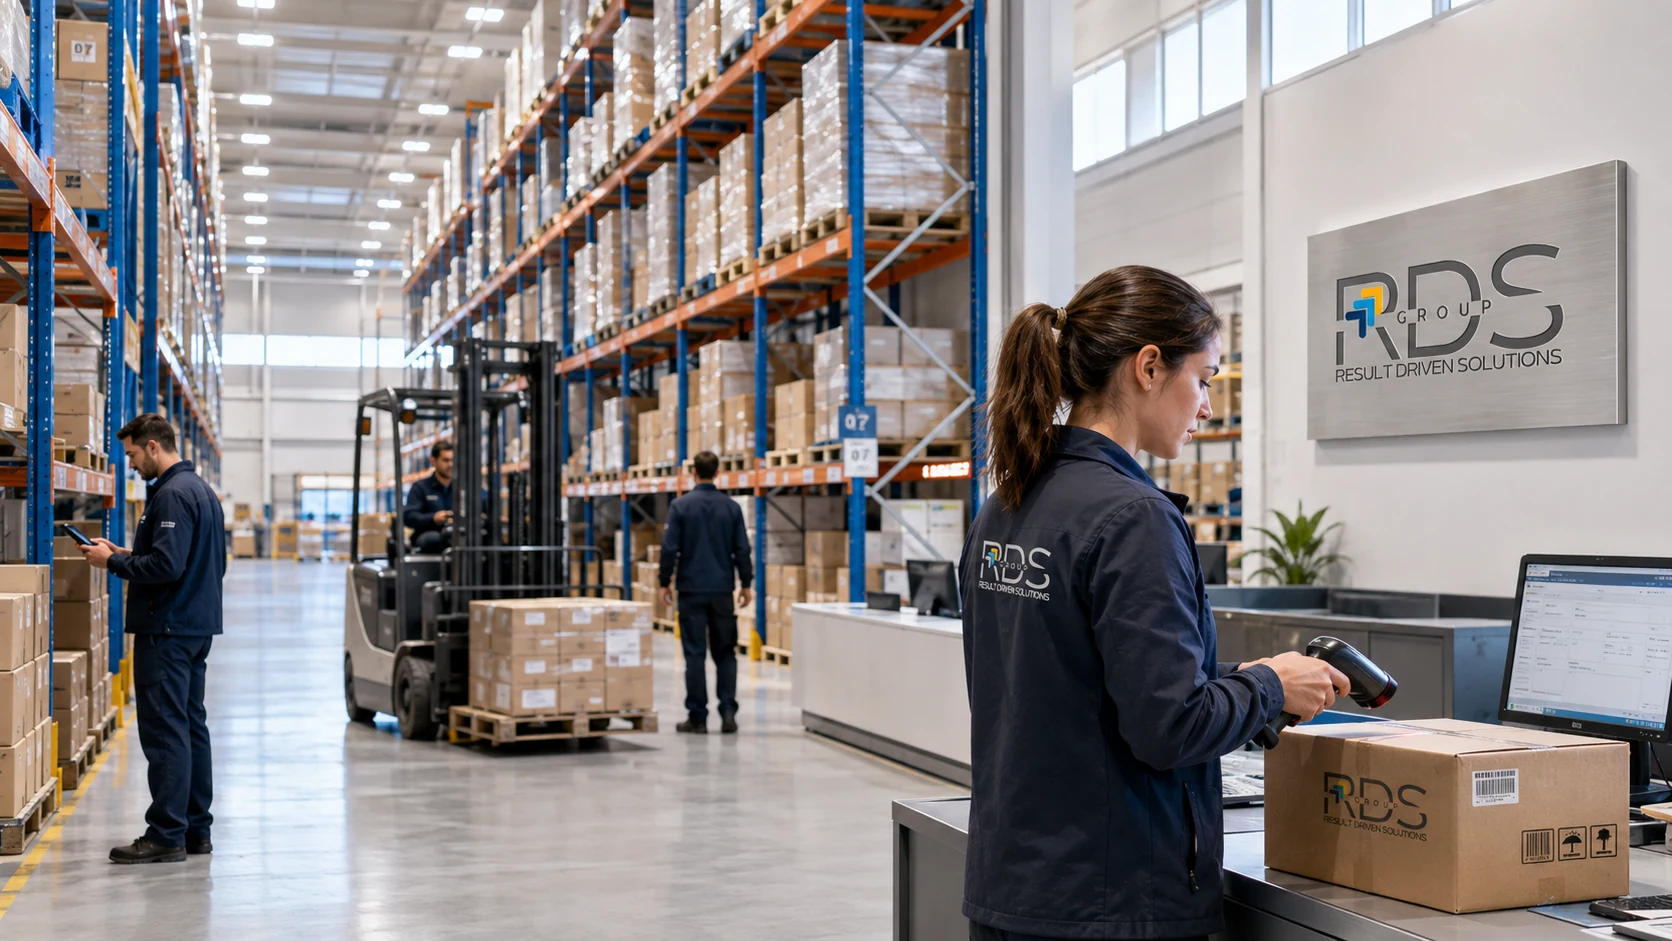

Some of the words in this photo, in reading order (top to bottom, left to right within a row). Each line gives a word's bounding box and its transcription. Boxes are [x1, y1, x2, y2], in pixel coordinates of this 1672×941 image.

[74, 43, 93, 56] 07
[1336, 243, 1564, 365] RDS
[1397, 299, 1492, 324] GROUP
[1335, 364, 1393, 383] RESULT
[1396, 359, 1454, 378] DRIVEN
[1457, 348, 1563, 373] SOLUTIONS
[851, 448, 869, 461] 07
[980, 540, 1052, 590] RDS
[1015, 587, 1050, 601] SOLUTIONS
[1324, 771, 1427, 830] RDS
[1323, 815, 1352, 827] RESULT
[1354, 820, 1382, 833] DRIVEN
[1382, 825, 1428, 842] SOLUTIONS
